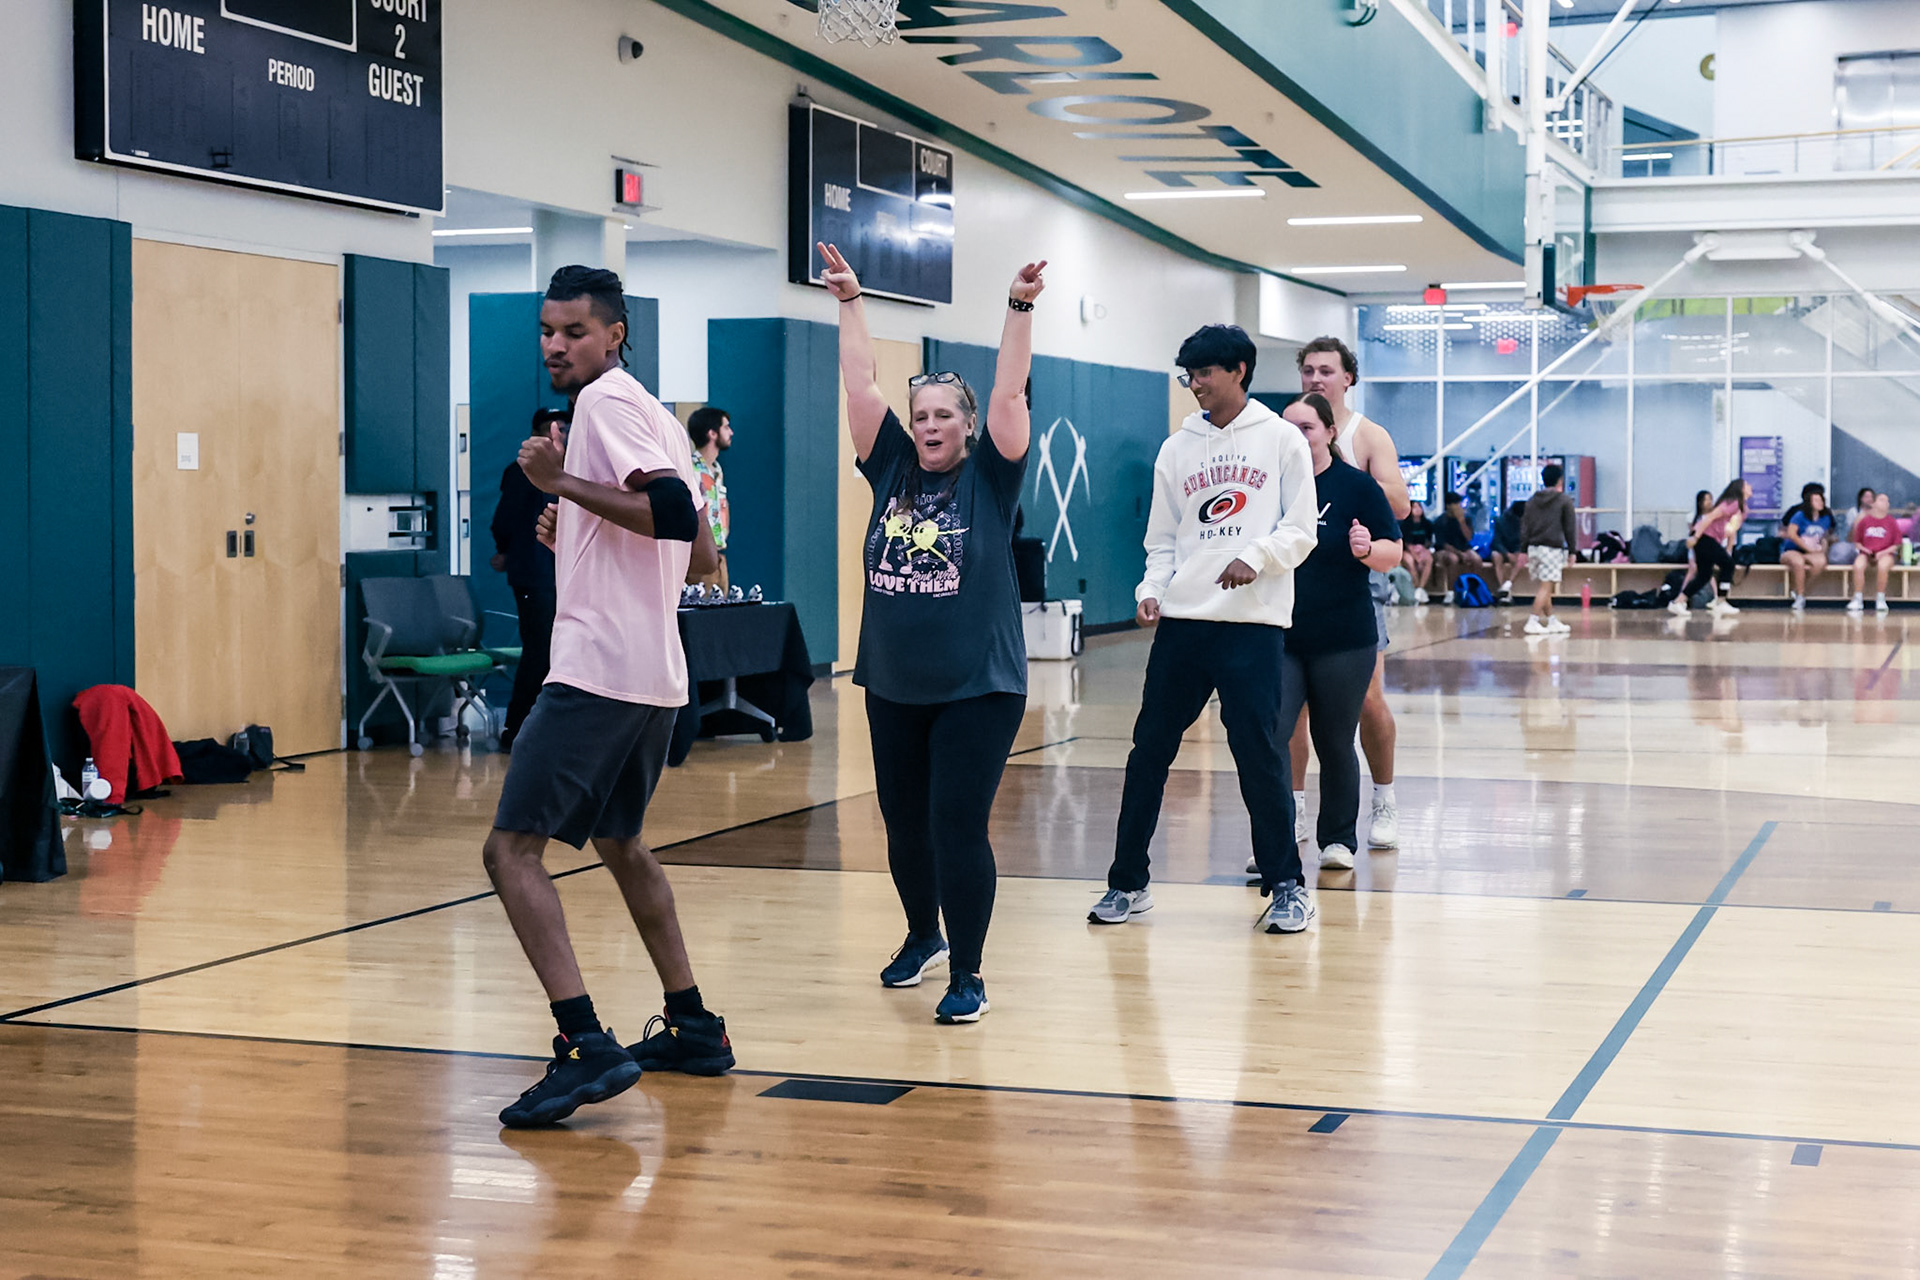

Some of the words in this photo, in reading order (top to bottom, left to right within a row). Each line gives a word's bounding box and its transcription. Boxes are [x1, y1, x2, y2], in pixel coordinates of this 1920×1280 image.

[142, 3, 205, 54] HOME
[394, 23, 406, 59] 2
[268, 58, 315, 92] PERIOD
[368, 63, 424, 107] GUEST
[824, 183, 851, 213] HOME
[869, 570, 905, 592] LOVE
[907, 576, 960, 593] THEM
